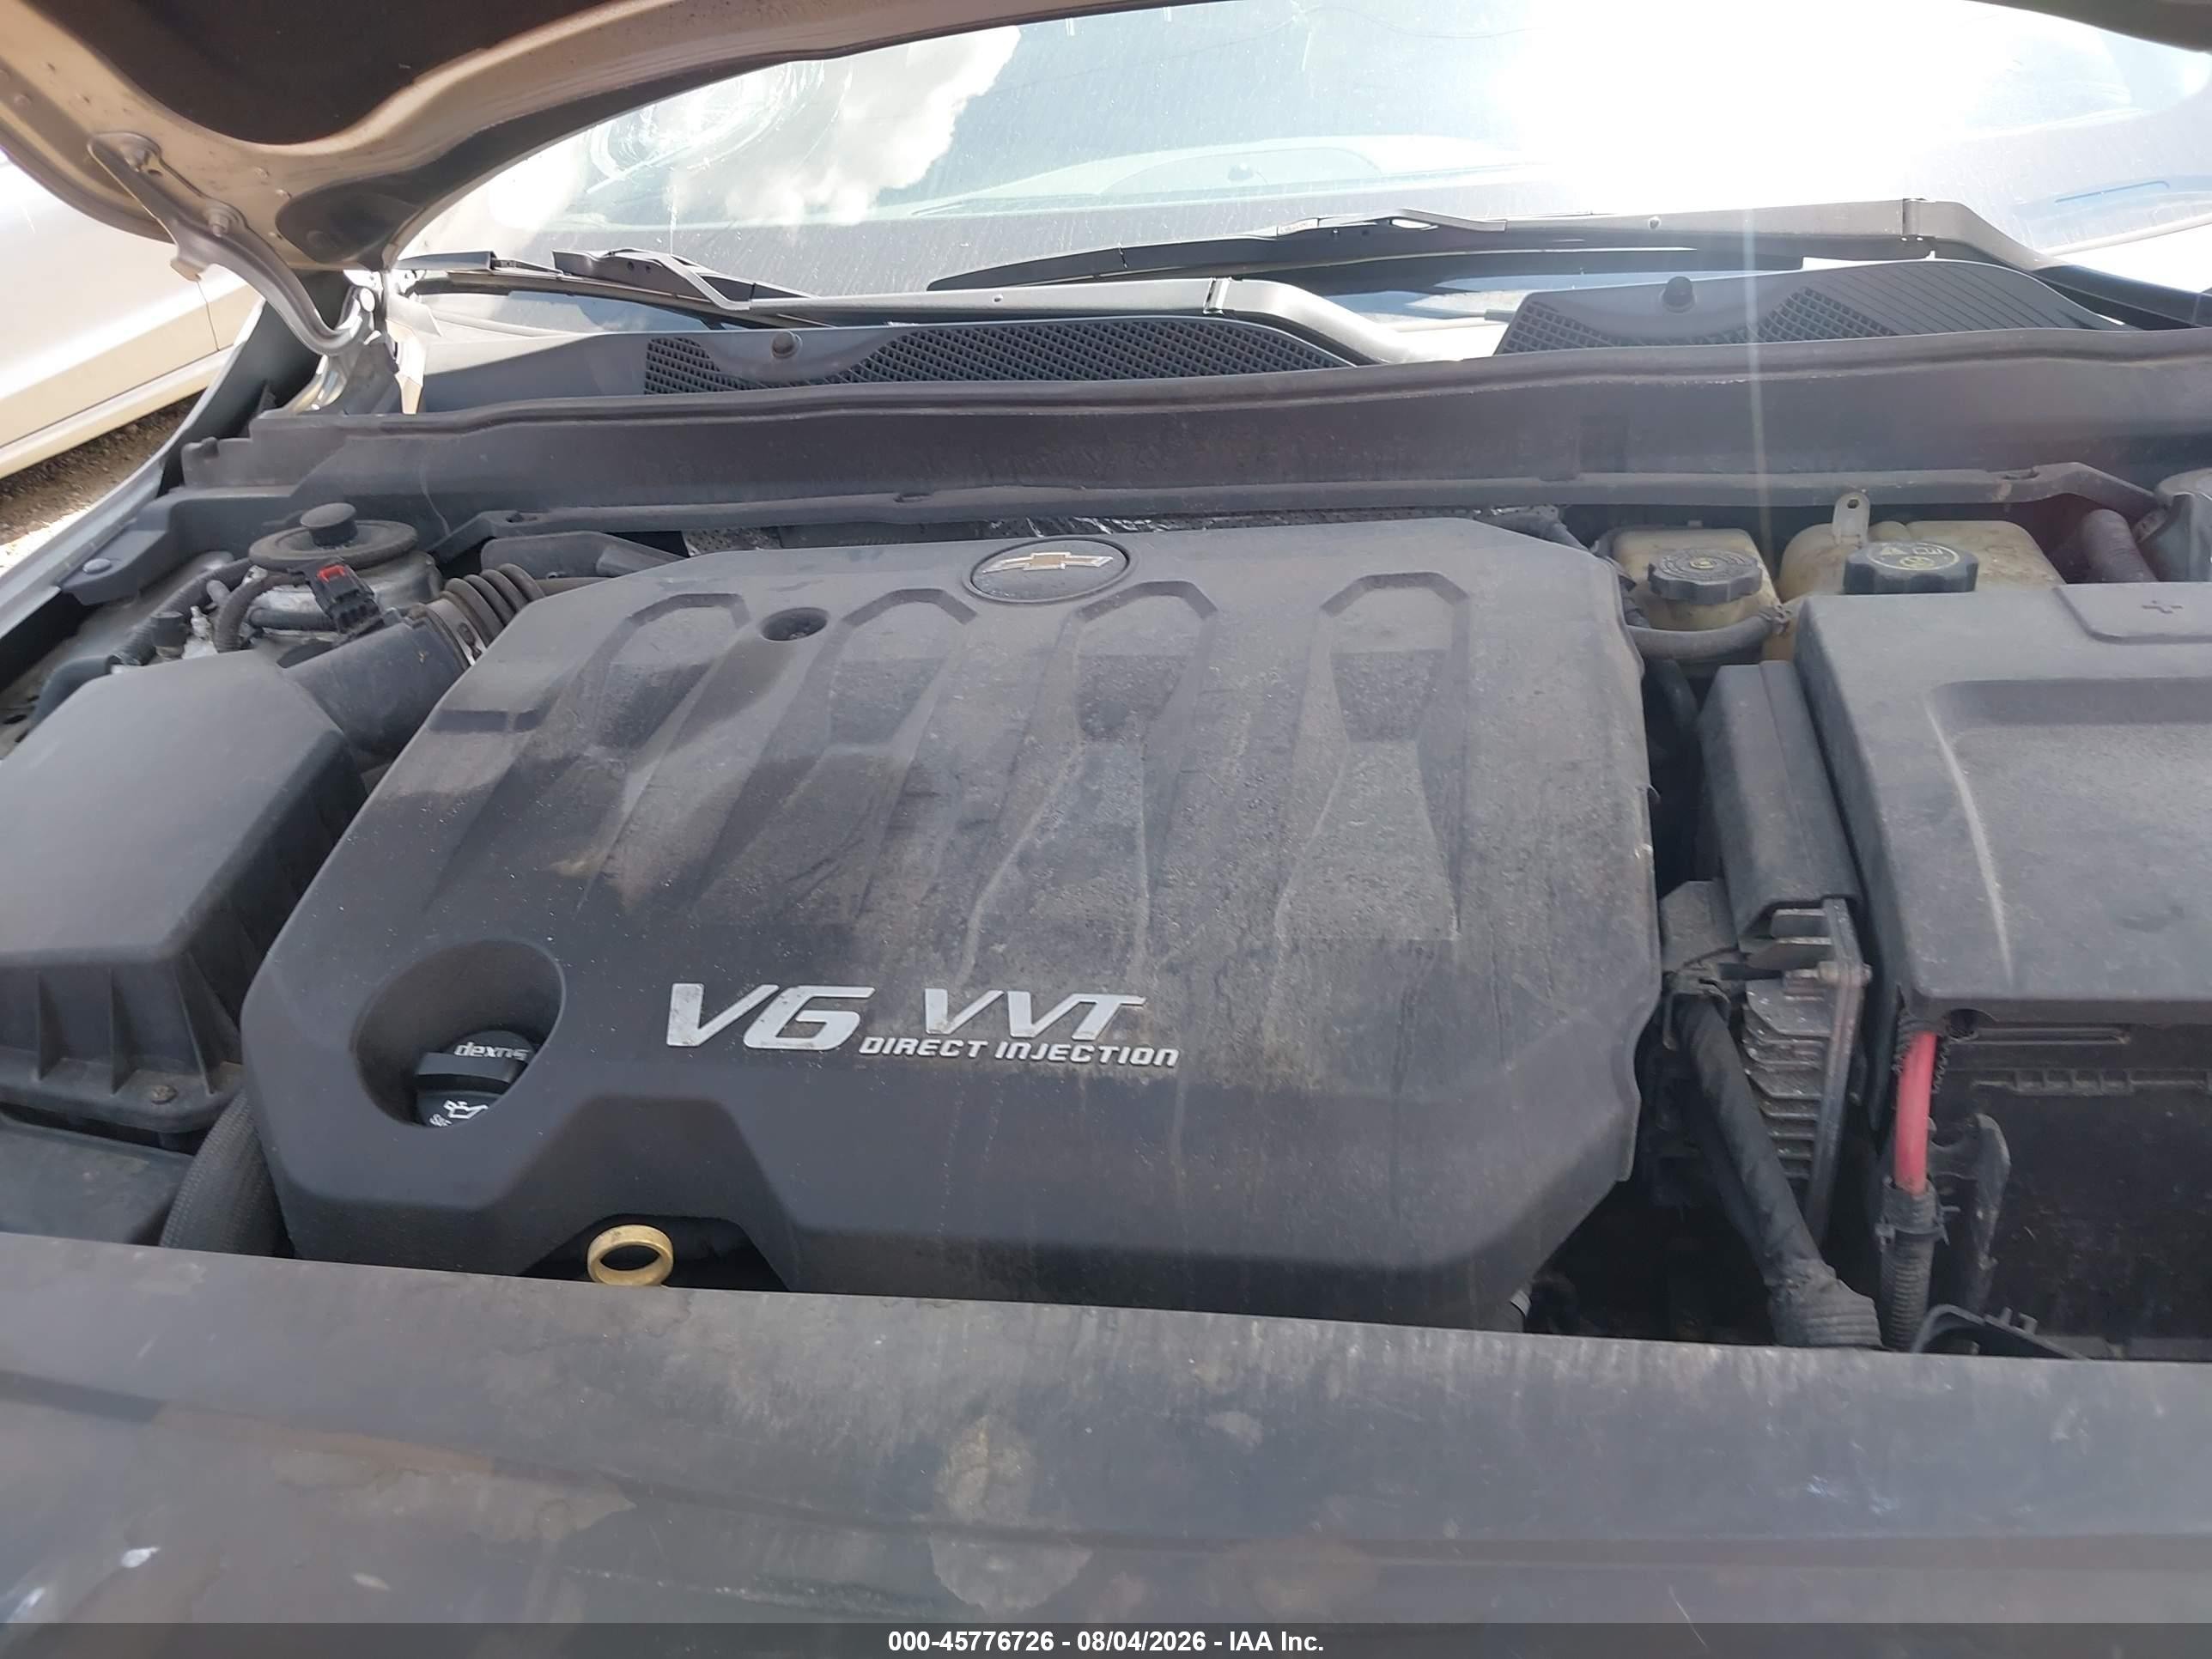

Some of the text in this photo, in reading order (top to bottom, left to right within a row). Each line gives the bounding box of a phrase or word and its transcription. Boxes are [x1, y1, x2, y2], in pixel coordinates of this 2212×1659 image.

[666, 982, 1147, 1051] V6 VVT
[858, 1036, 1180, 1067] DIRECT INJECTION
